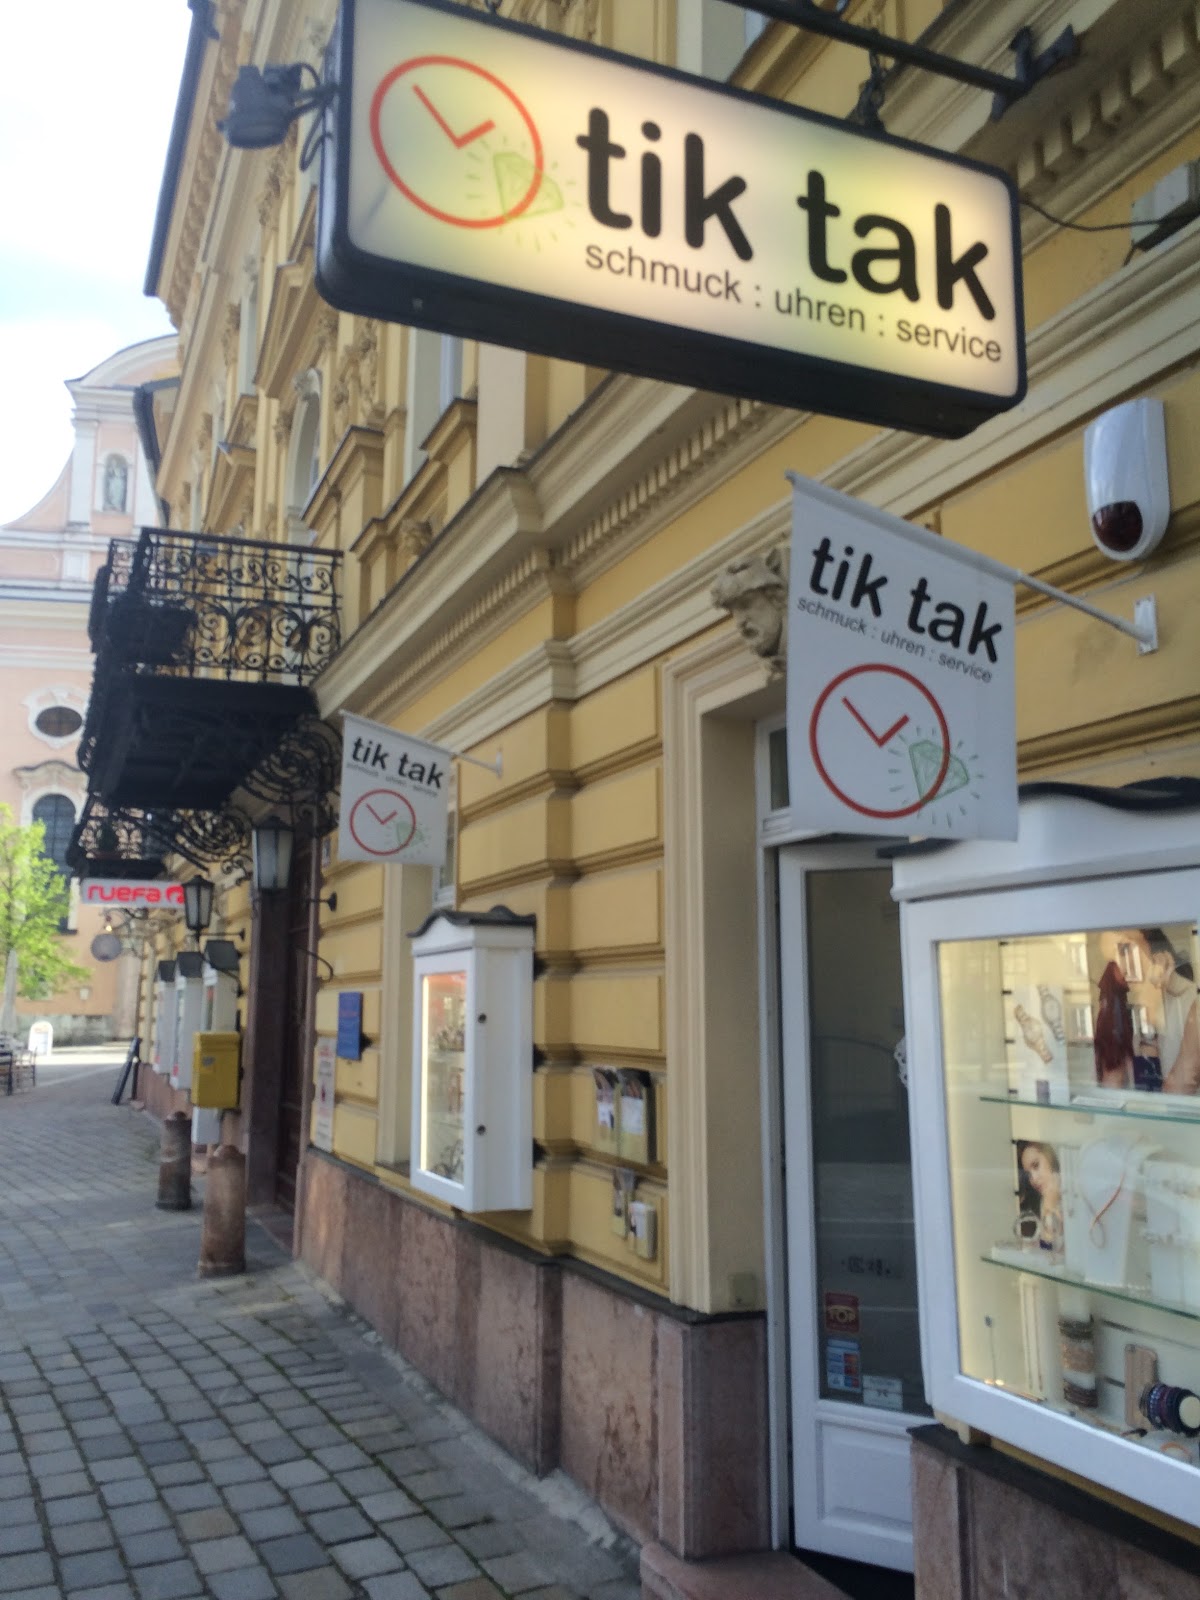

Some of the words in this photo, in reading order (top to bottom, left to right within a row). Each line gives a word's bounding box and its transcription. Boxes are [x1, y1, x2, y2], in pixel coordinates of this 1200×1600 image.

[576, 107, 753, 261] tik
[797, 169, 996, 320] tak
[585, 243, 742, 303] schmuck
[775, 286, 866, 333] uhren
[896, 316, 1002, 363] service
[797, 598, 867, 635] schmuck
[880, 632, 925, 657] uhren
[938, 652, 993, 684] service
[809, 537, 888, 617] tik
[907, 578, 1002, 663] tak
[352, 736, 389, 770] tik
[398, 753, 444, 789] tak
